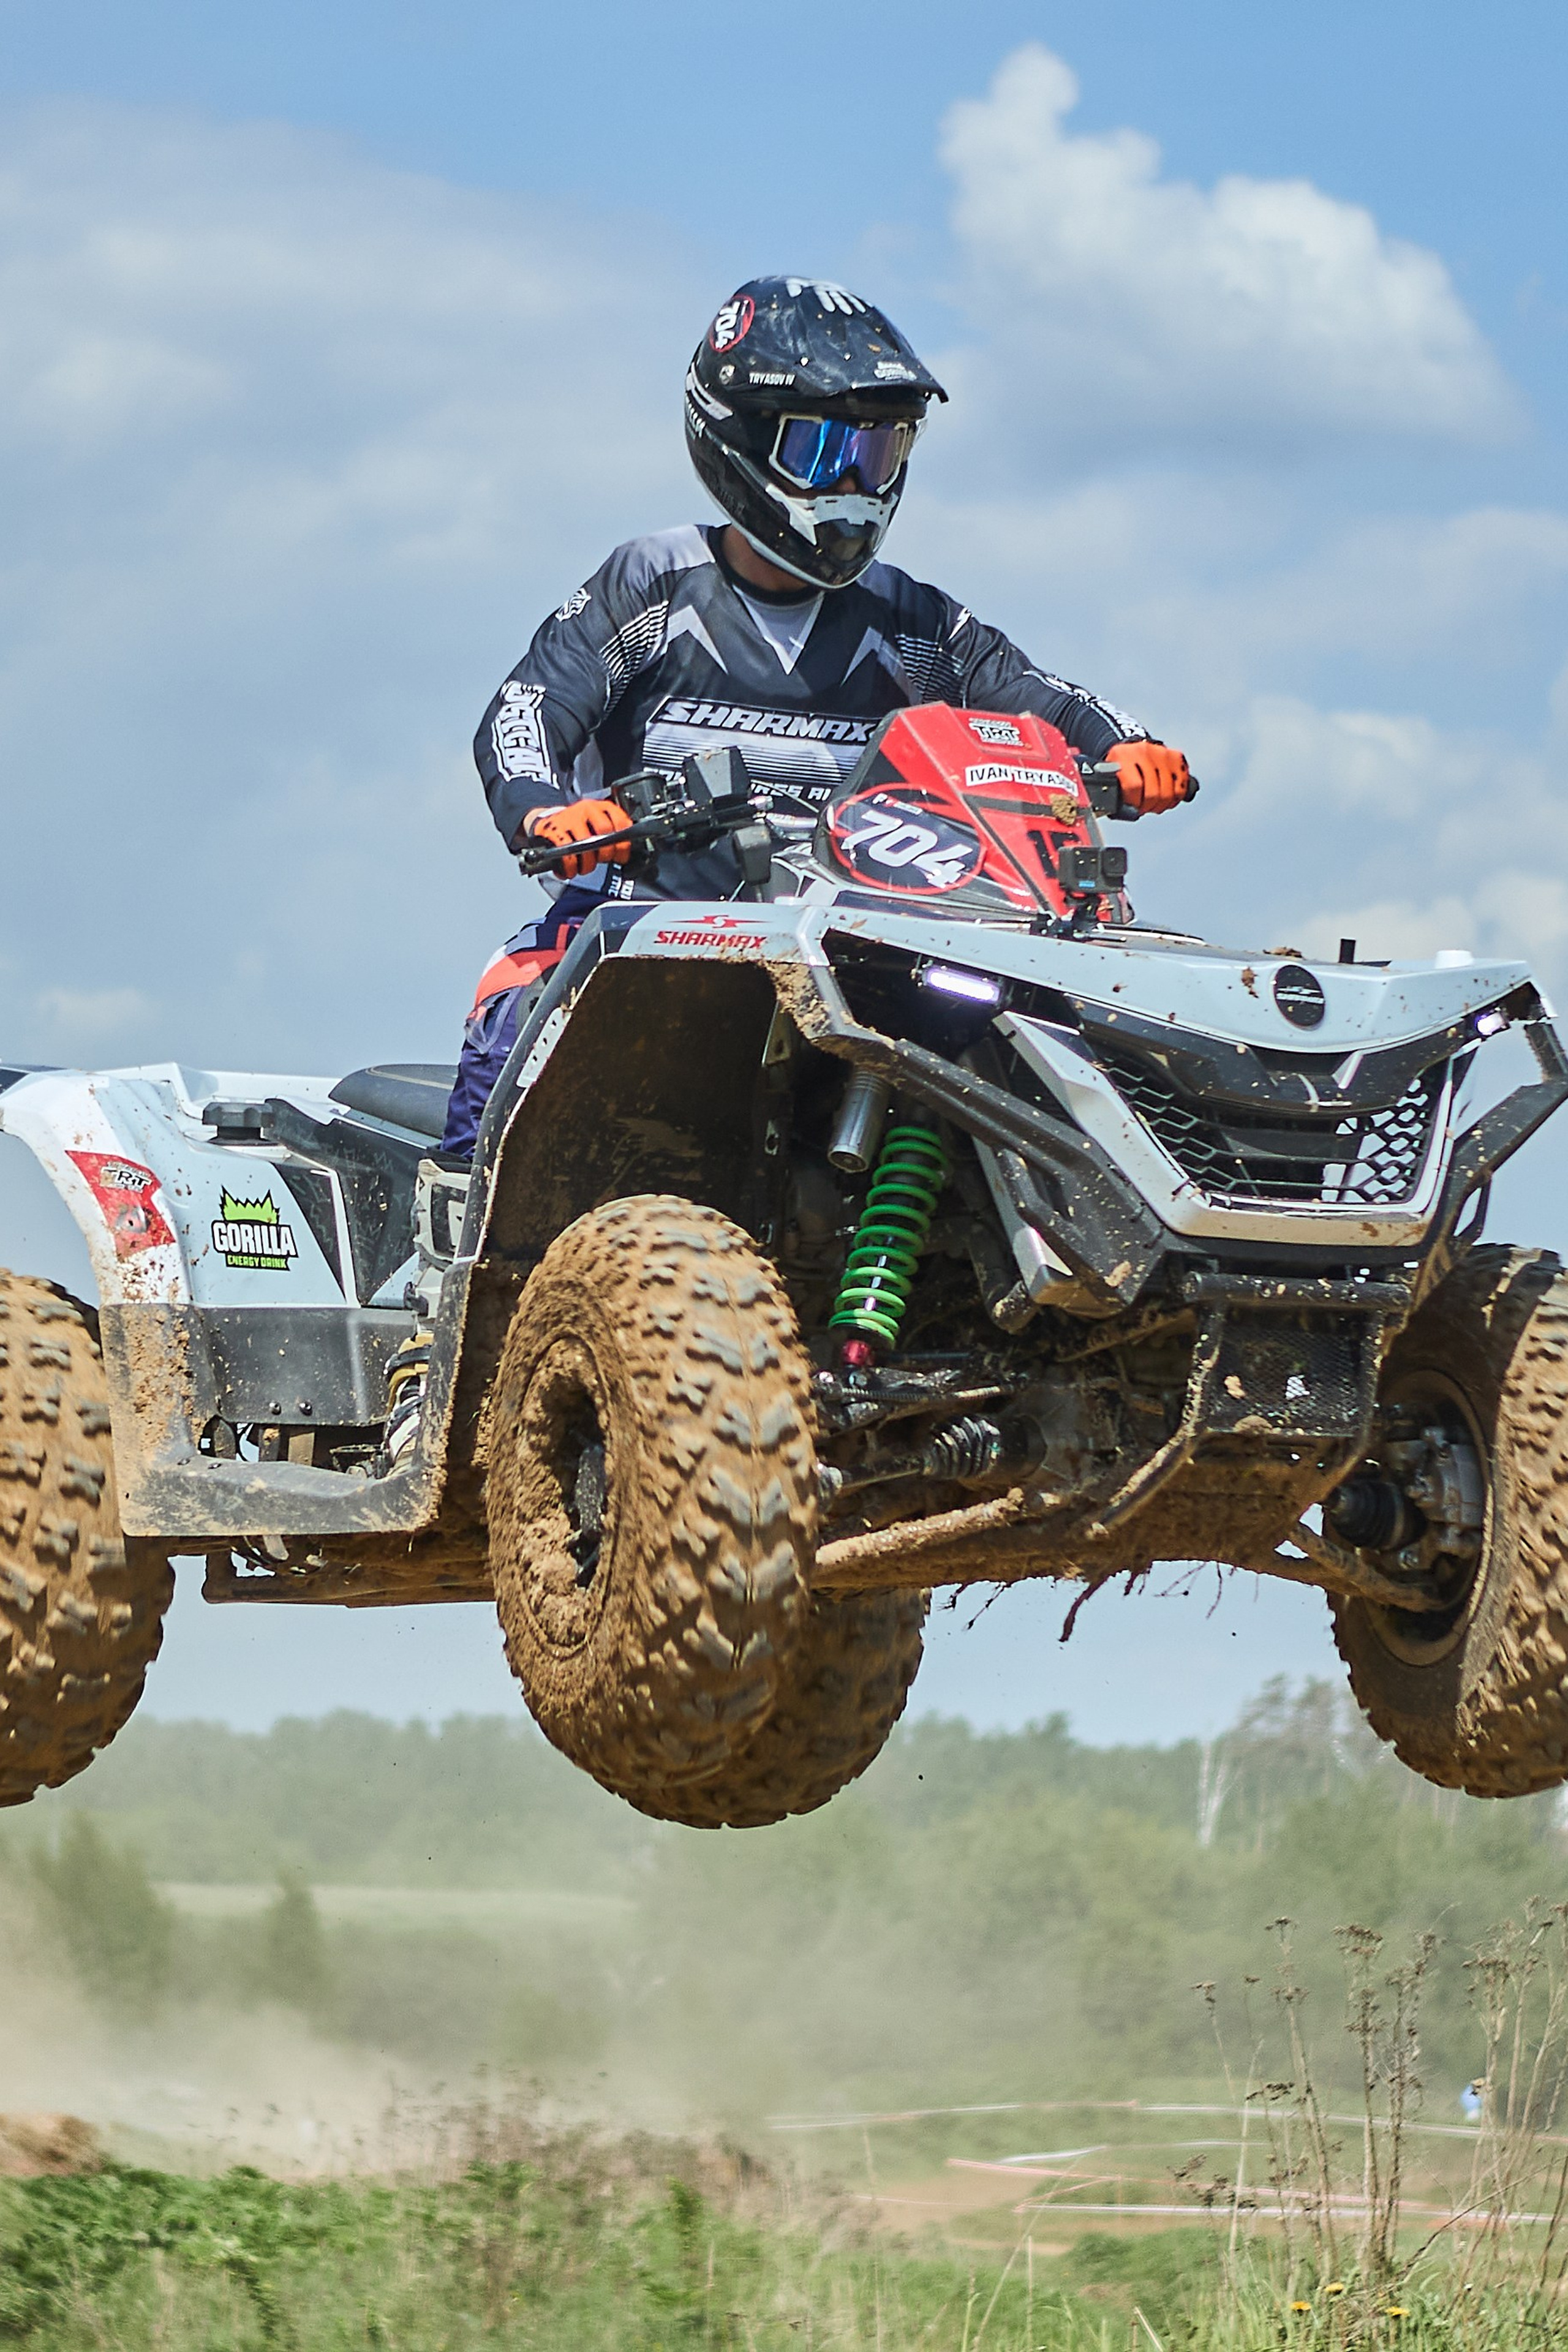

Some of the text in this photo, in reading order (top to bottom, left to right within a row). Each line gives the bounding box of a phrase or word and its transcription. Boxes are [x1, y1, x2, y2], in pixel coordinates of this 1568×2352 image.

[749, 372, 785, 385] TRYASOV
[657, 701, 877, 742] SHARMAX
[970, 766, 1009, 782] IVAN
[841, 810, 973, 888] 704
[654, 930, 767, 949] SHARMAX
[213, 1222, 296, 1256] GORILLA
[227, 1254, 287, 1268] ENERGY DRINK
